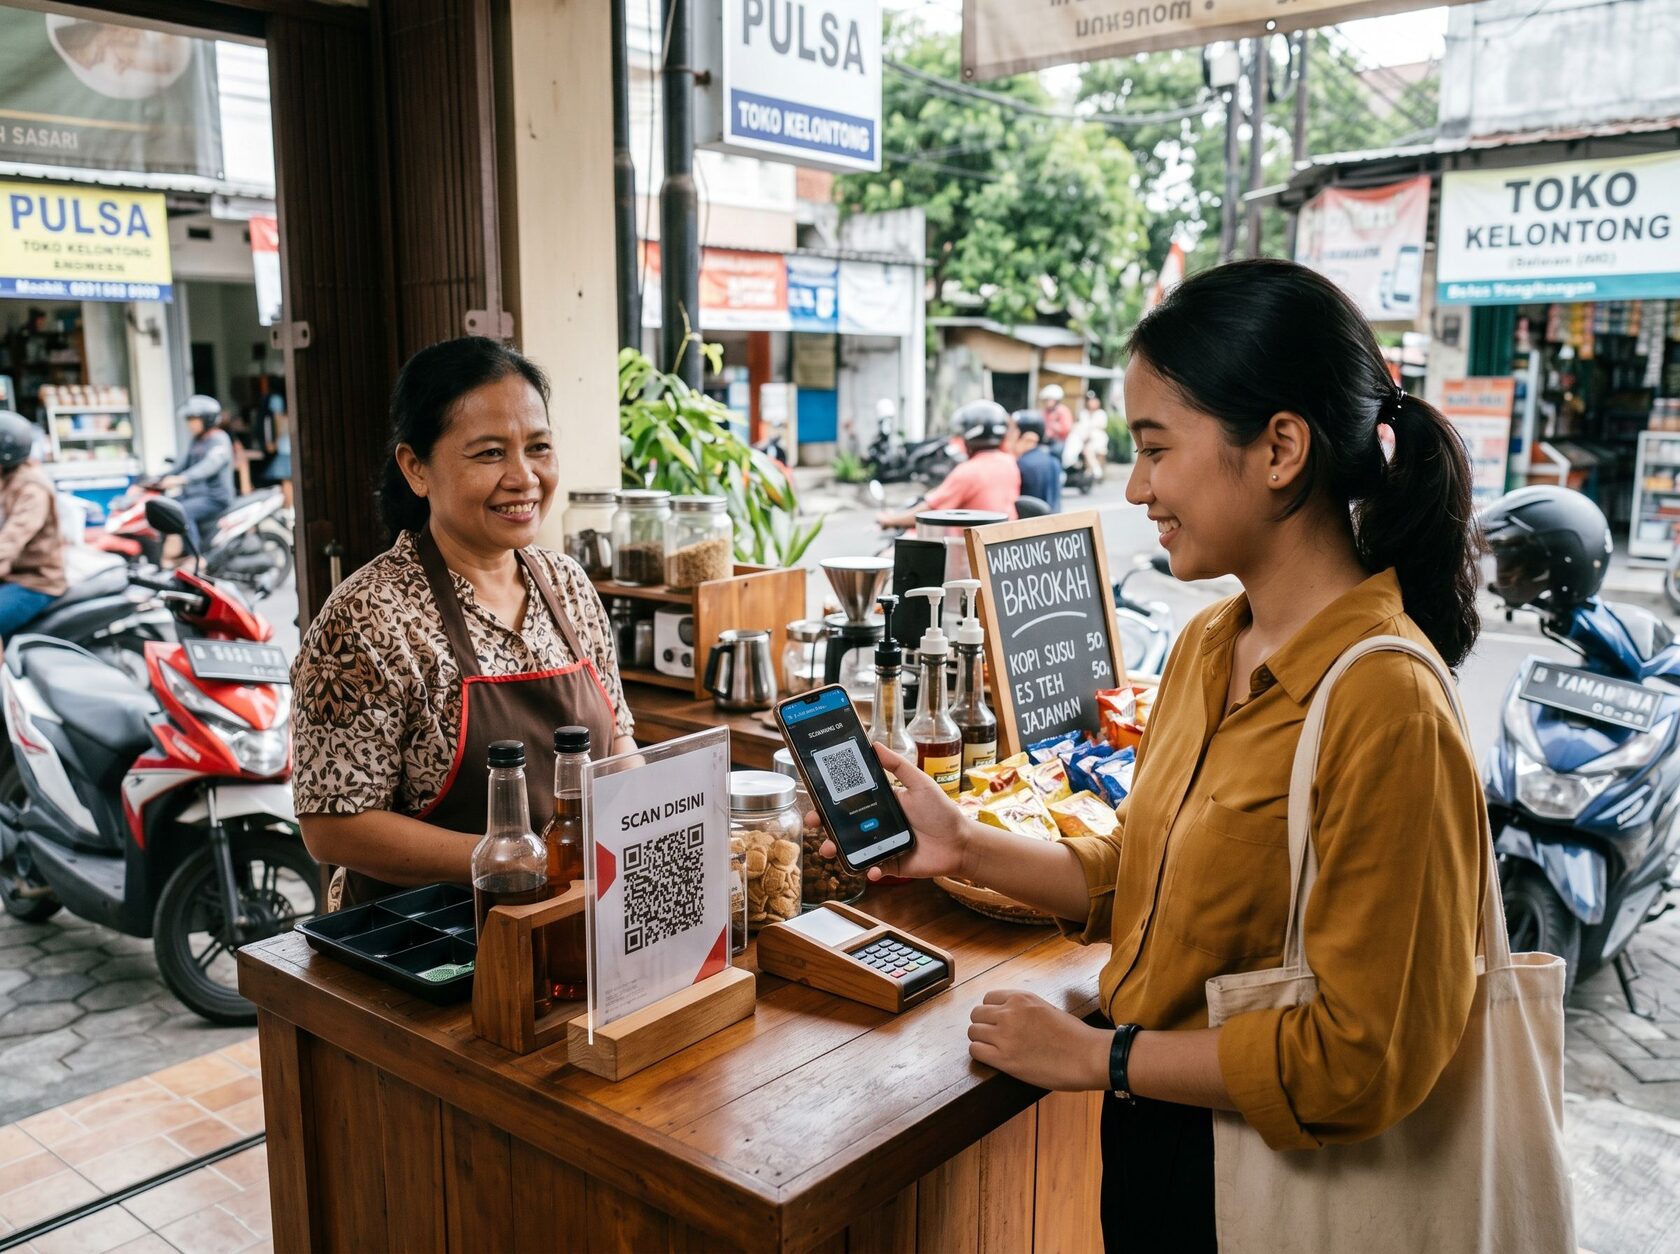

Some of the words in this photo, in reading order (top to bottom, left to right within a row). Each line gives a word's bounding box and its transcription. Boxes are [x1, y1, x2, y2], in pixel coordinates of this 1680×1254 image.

[743, 0, 865, 75] PULSA
[12, 126, 79, 150] SASARI
[737, 100, 782, 136] TOKO
[783, 109, 870, 153] KELONTONG
[1505, 171, 1637, 214] TOKO
[9, 194, 152, 239] PULSA
[1466, 214, 1671, 250] KELONTONG
[988, 540, 1051, 575] WARUNG
[1054, 532, 1087, 562] KOPI
[1001, 564, 1091, 616] BAROKAH
[1009, 649, 1041, 677] KOPI
[1045, 639, 1076, 666] SUSU
[1015, 683, 1034, 705] ES
[1036, 672, 1065, 699] TEH
[1021, 696, 1082, 736] JAJANAN
[621, 806, 661, 832] SCAN
[664, 792, 705, 819] DISINI
